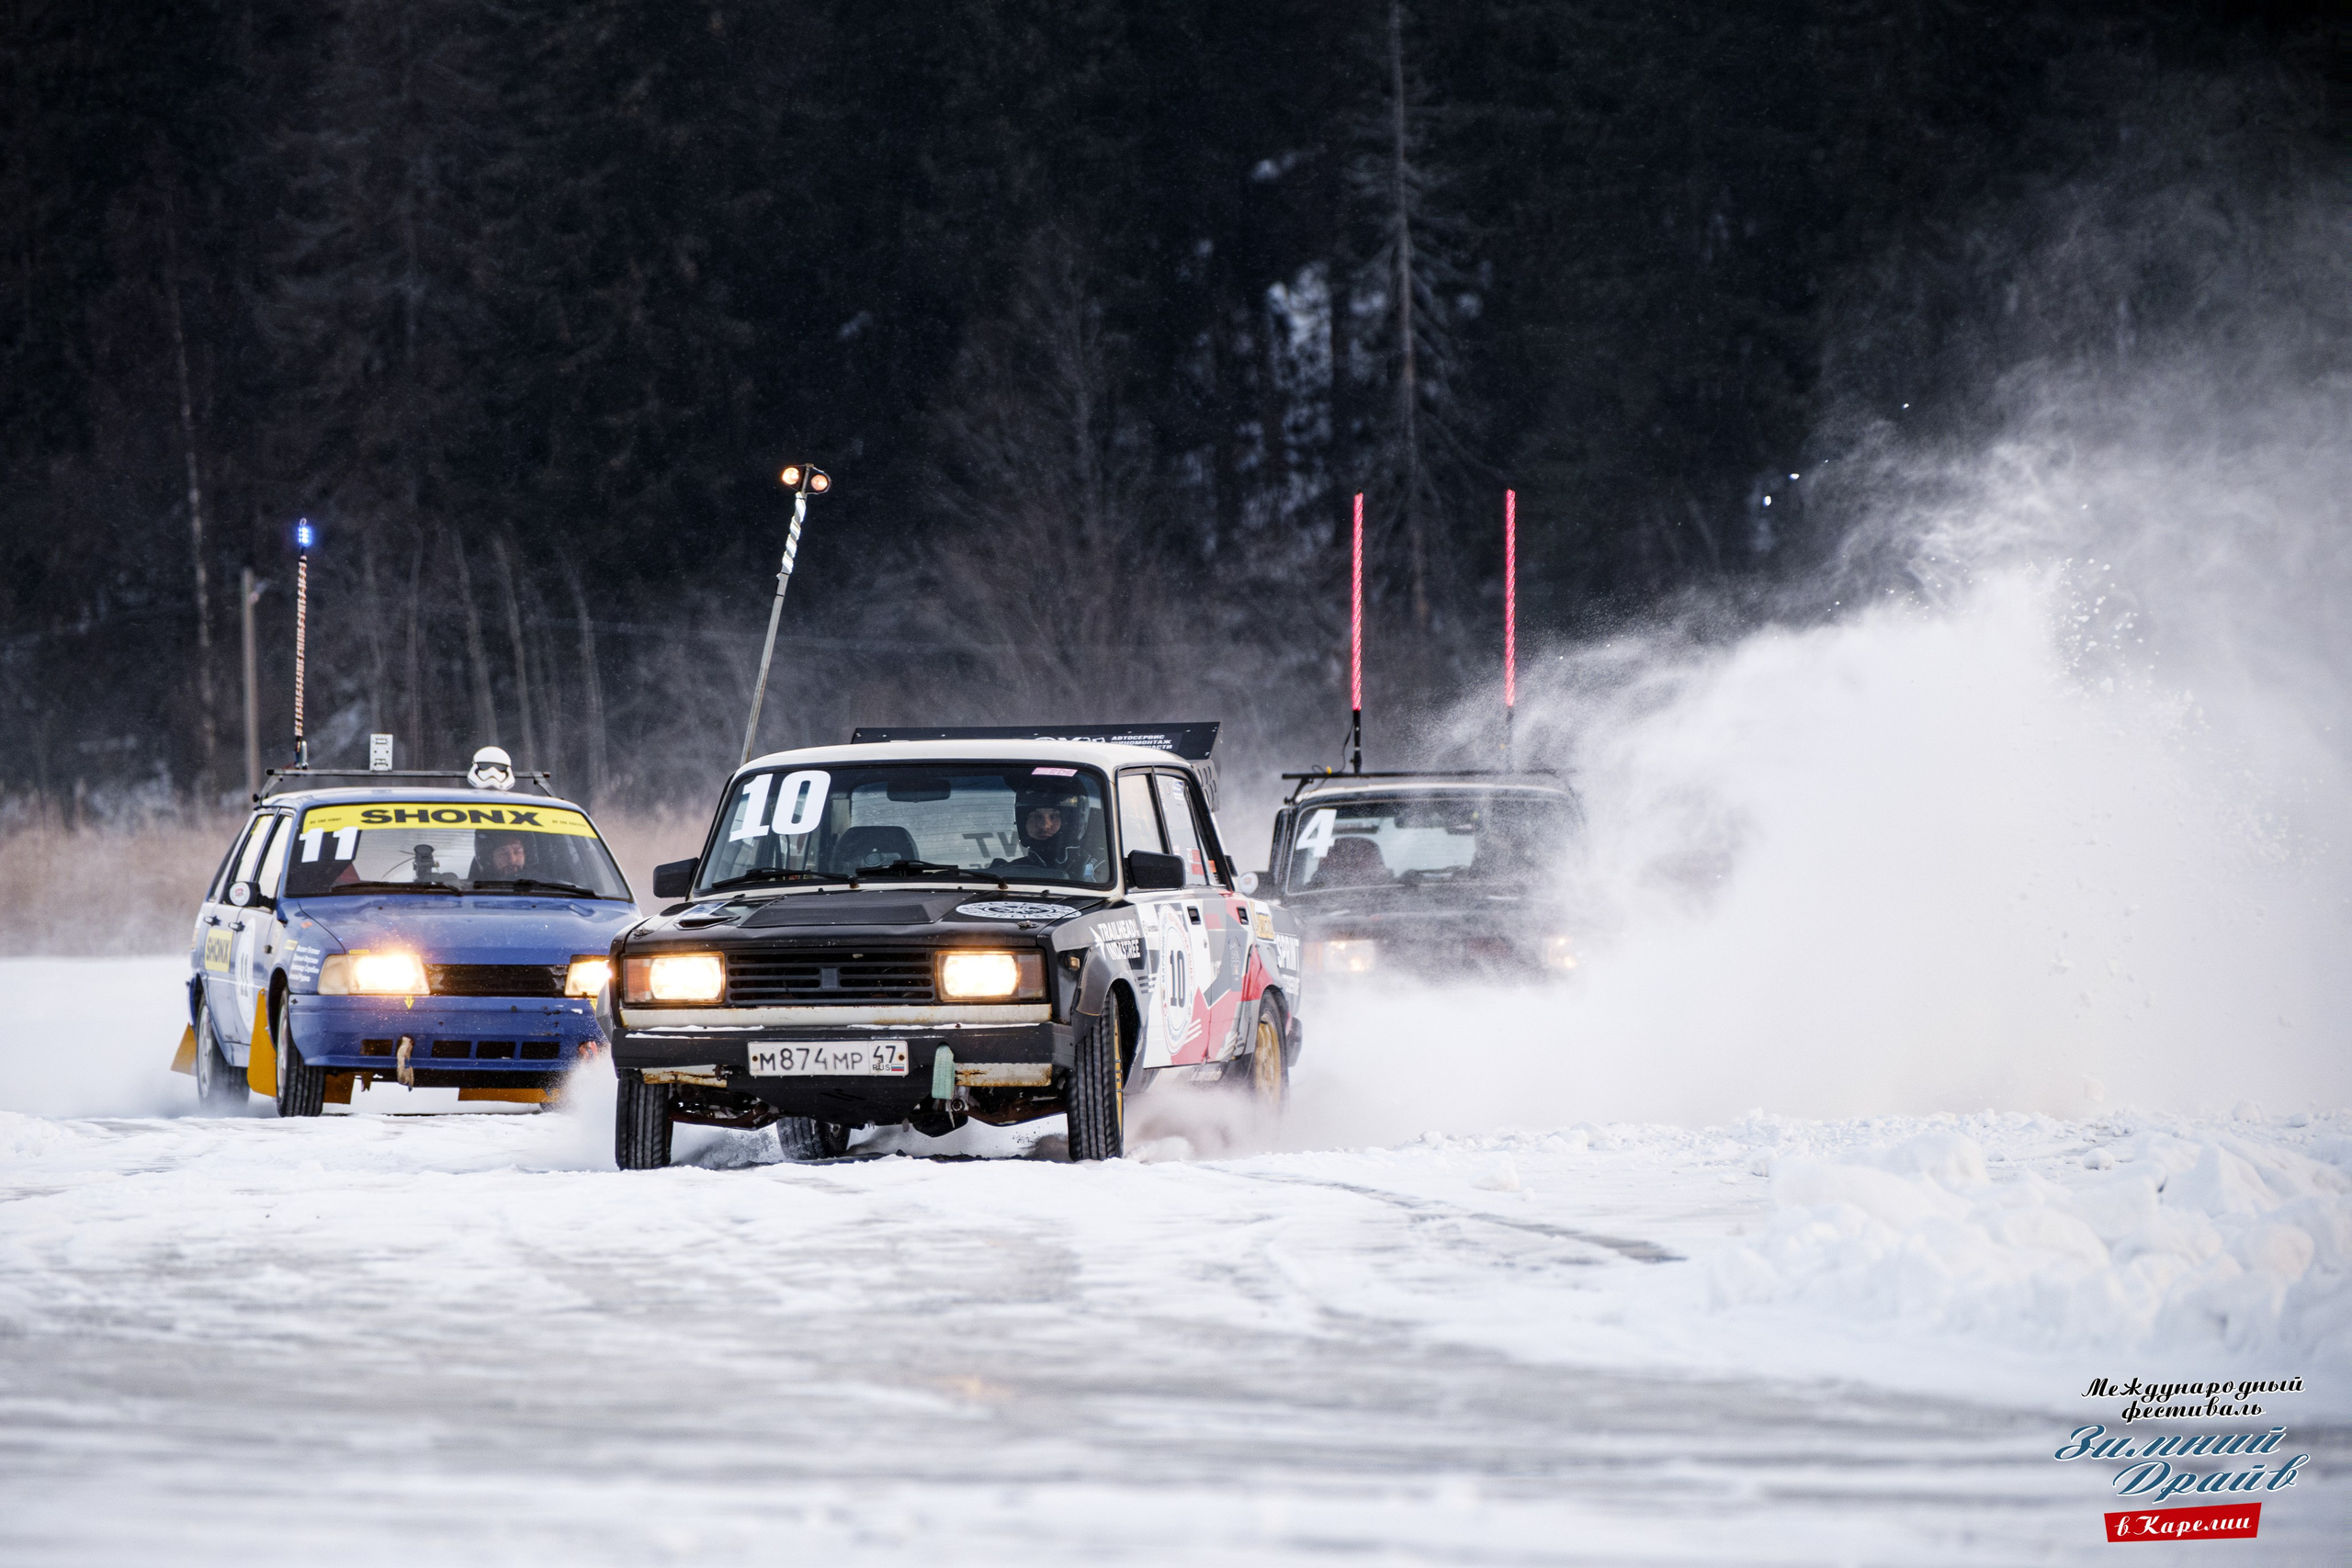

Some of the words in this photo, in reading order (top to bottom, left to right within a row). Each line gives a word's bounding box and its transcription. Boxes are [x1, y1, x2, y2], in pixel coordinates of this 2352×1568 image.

[361, 809, 544, 827] SHONX
[729, 770, 831, 842] 10
[299, 826, 358, 863] 11
[1295, 808, 1337, 858] 4
[206, 936, 231, 964] SHONX
[1170, 949, 1185, 1008] 10
[872, 1064, 891, 1072] RUS
